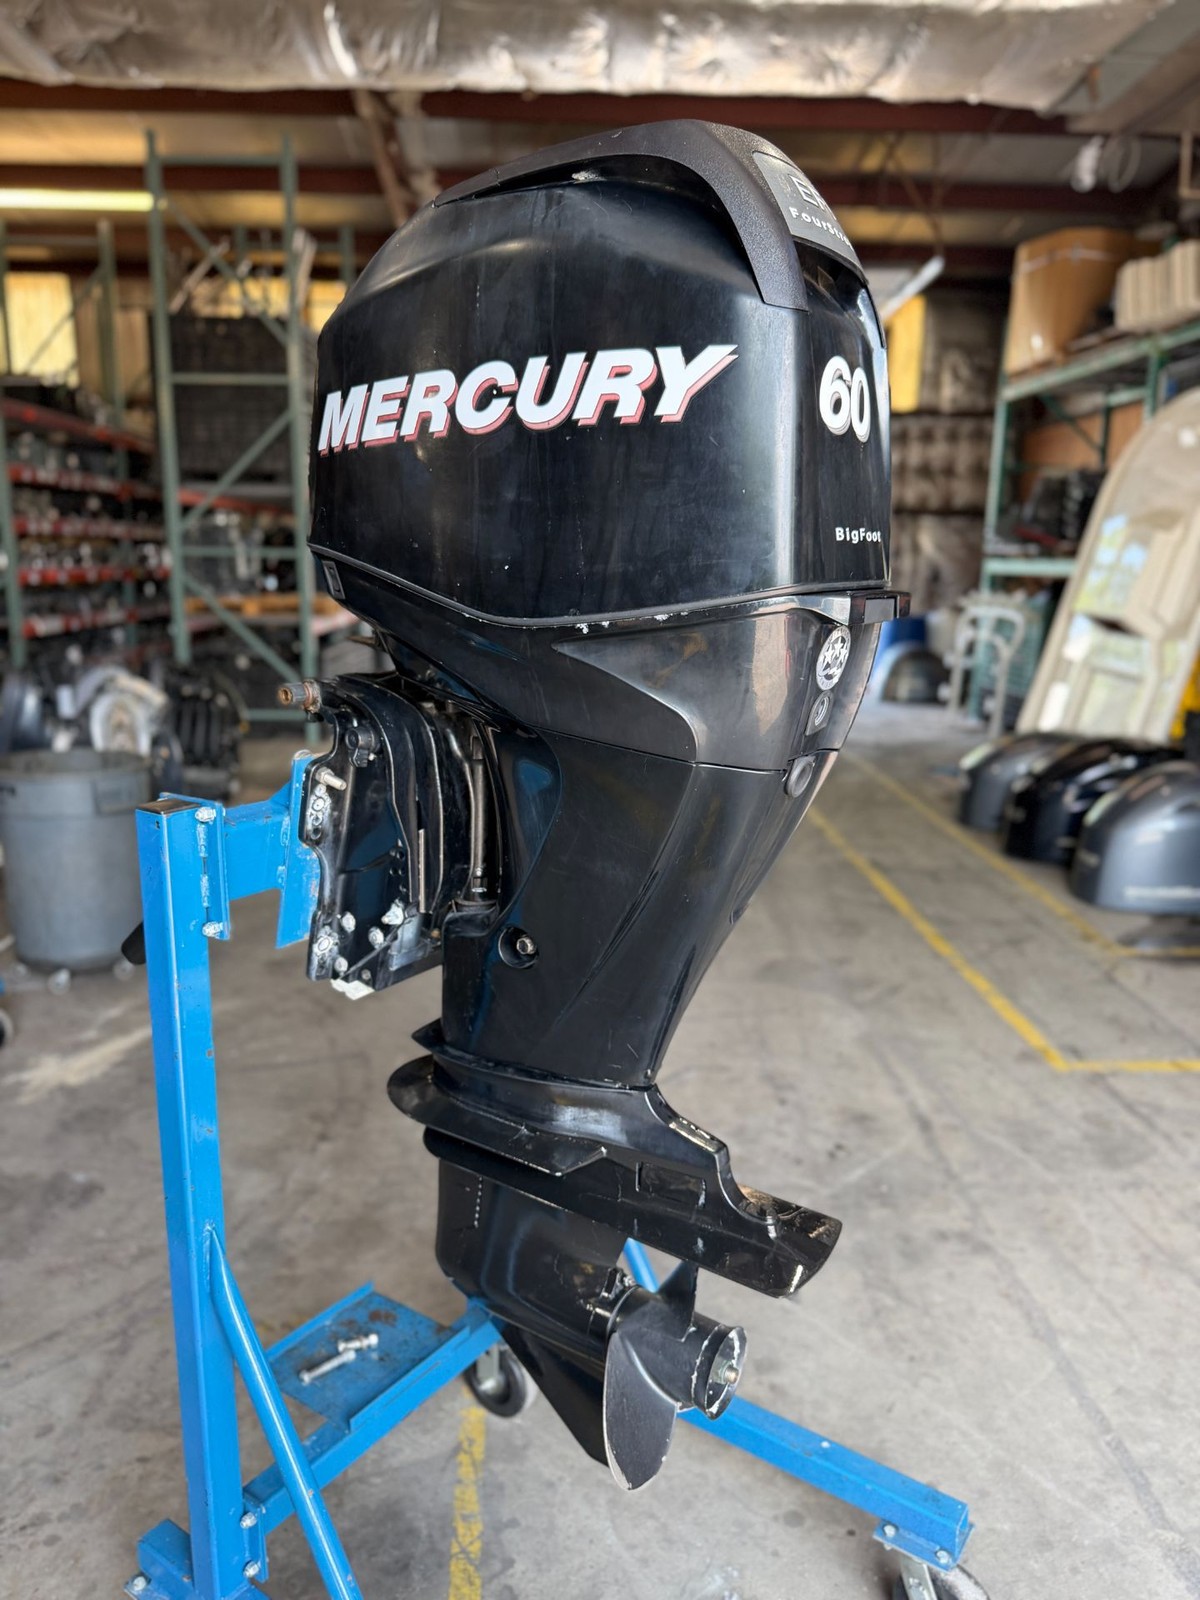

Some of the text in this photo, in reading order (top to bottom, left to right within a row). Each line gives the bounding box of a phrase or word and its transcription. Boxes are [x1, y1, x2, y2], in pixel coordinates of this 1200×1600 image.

[317, 344, 739, 457] MERCURY
[819, 355, 871, 443] 60
[835, 526, 881, 544] BigFoot
